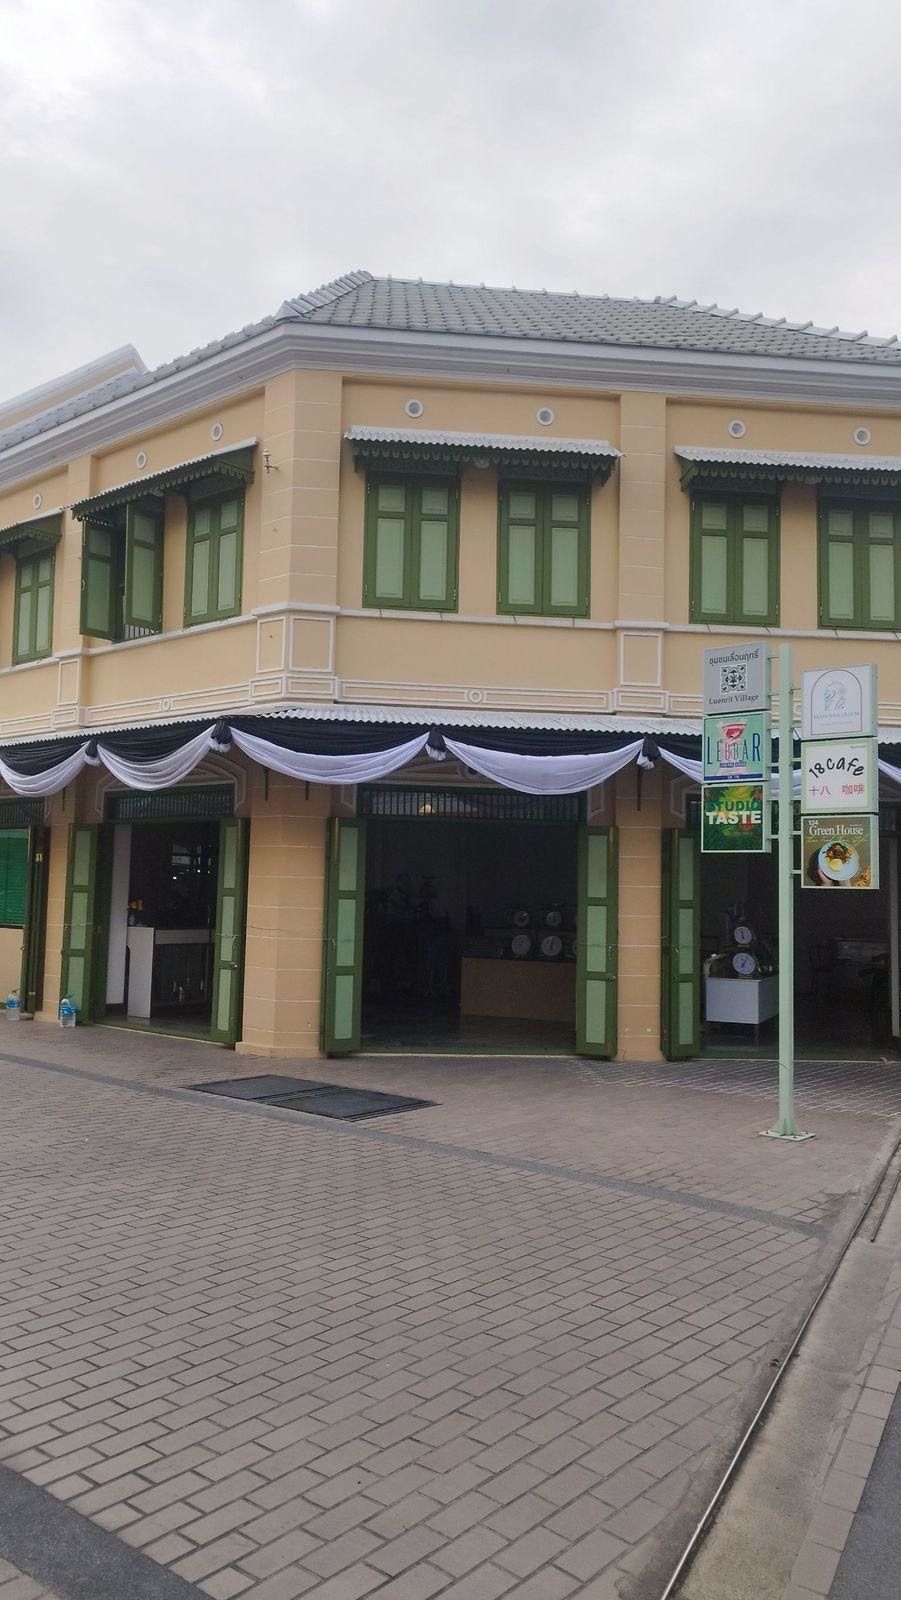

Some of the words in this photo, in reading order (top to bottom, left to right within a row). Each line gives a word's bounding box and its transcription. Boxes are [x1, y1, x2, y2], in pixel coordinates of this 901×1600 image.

[709, 696, 733, 705] Luenrit
[735, 693, 759, 703] Village
[809, 785, 831, 797] 十八
[842, 783, 865, 795] 咖啡
[706, 799, 760, 812] STUDIO
[706, 810, 762, 825] TASTE
[809, 825, 835, 836] Green
[836, 824, 864, 835] House
